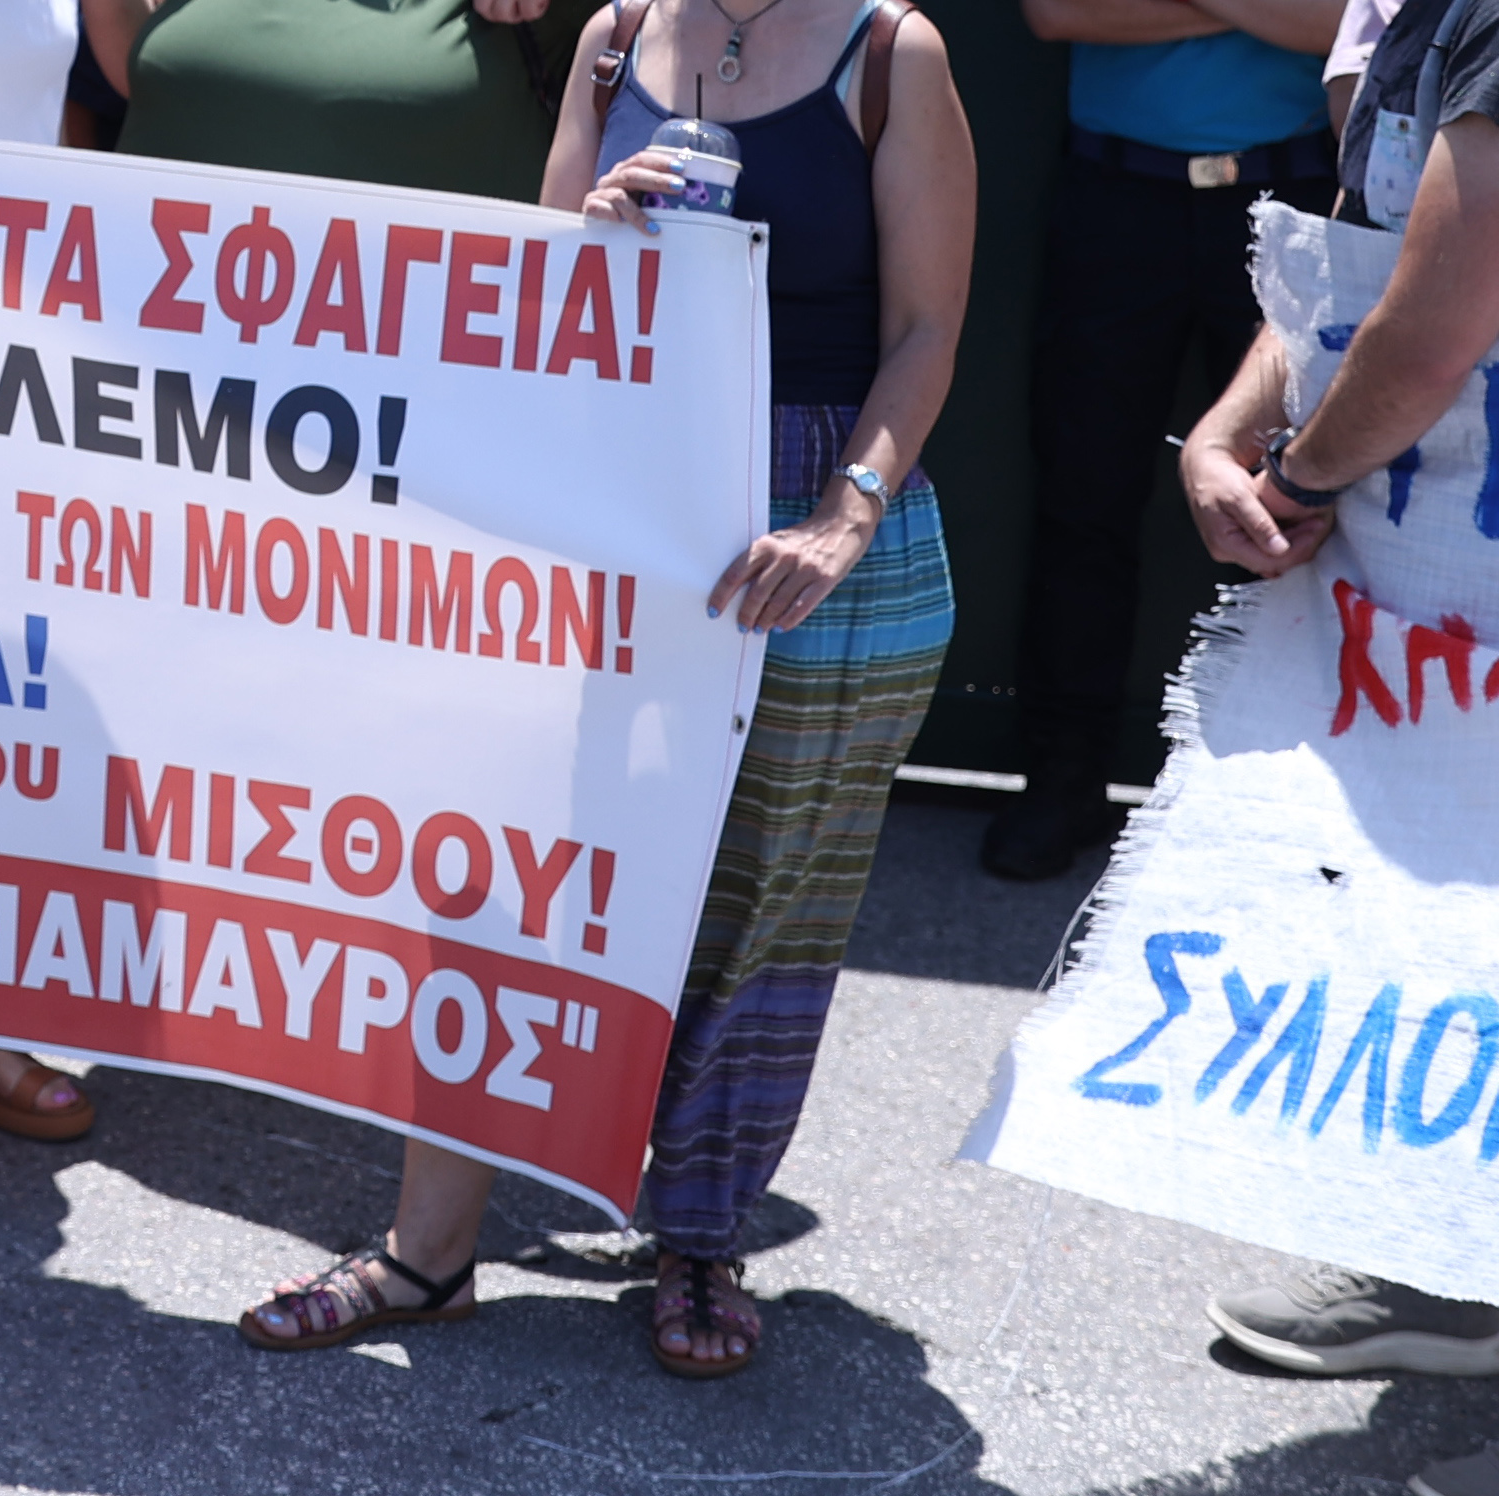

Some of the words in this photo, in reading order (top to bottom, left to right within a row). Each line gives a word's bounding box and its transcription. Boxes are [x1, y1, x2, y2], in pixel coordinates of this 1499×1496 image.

[139, 198, 661, 385] ΣΦΑΓΕΙΑ!
[16, 491, 153, 599] ΤΩΝ
[183, 502, 635, 675] ΜΟΝΙΜΩΝ!
[103, 754, 617, 958] ΜΙΣΘΟΥ!
[1075, 931, 1499, 1166] ΣΥΛΛΟ
